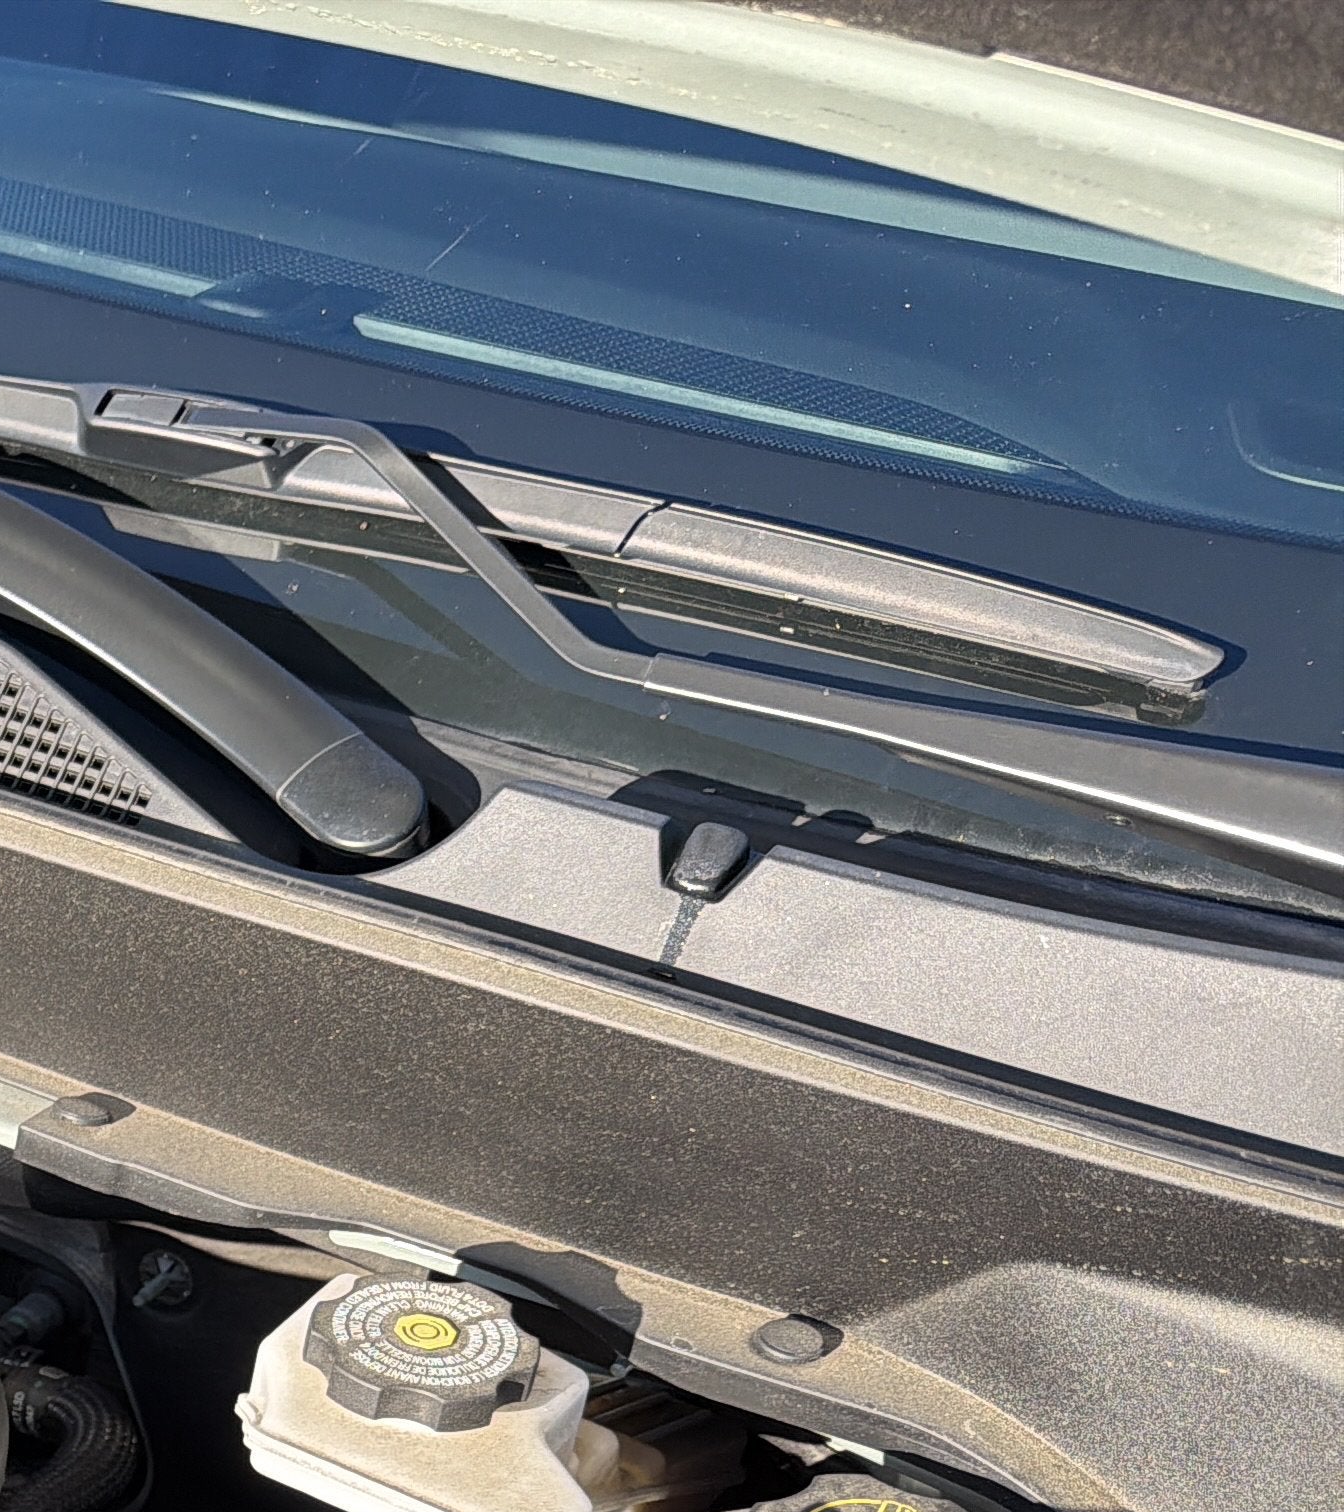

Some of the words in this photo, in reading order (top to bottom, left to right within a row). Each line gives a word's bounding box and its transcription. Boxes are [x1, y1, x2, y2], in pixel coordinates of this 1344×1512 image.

[391, 1281, 426, 1291] FROM
[429, 1282, 465, 1298] FLUID
[345, 1284, 383, 1304] SEALED
[413, 1290, 460, 1307] BEFORE
[380, 1356, 411, 1371] FREIN
[413, 1355, 443, 1366] BIDON
[384, 1368, 420, 1384] AVANT
[412, 1365, 426, 1375] DE
[428, 1366, 464, 1376] LIQUIDE
[421, 1376, 472, 1387] BOUCHON
